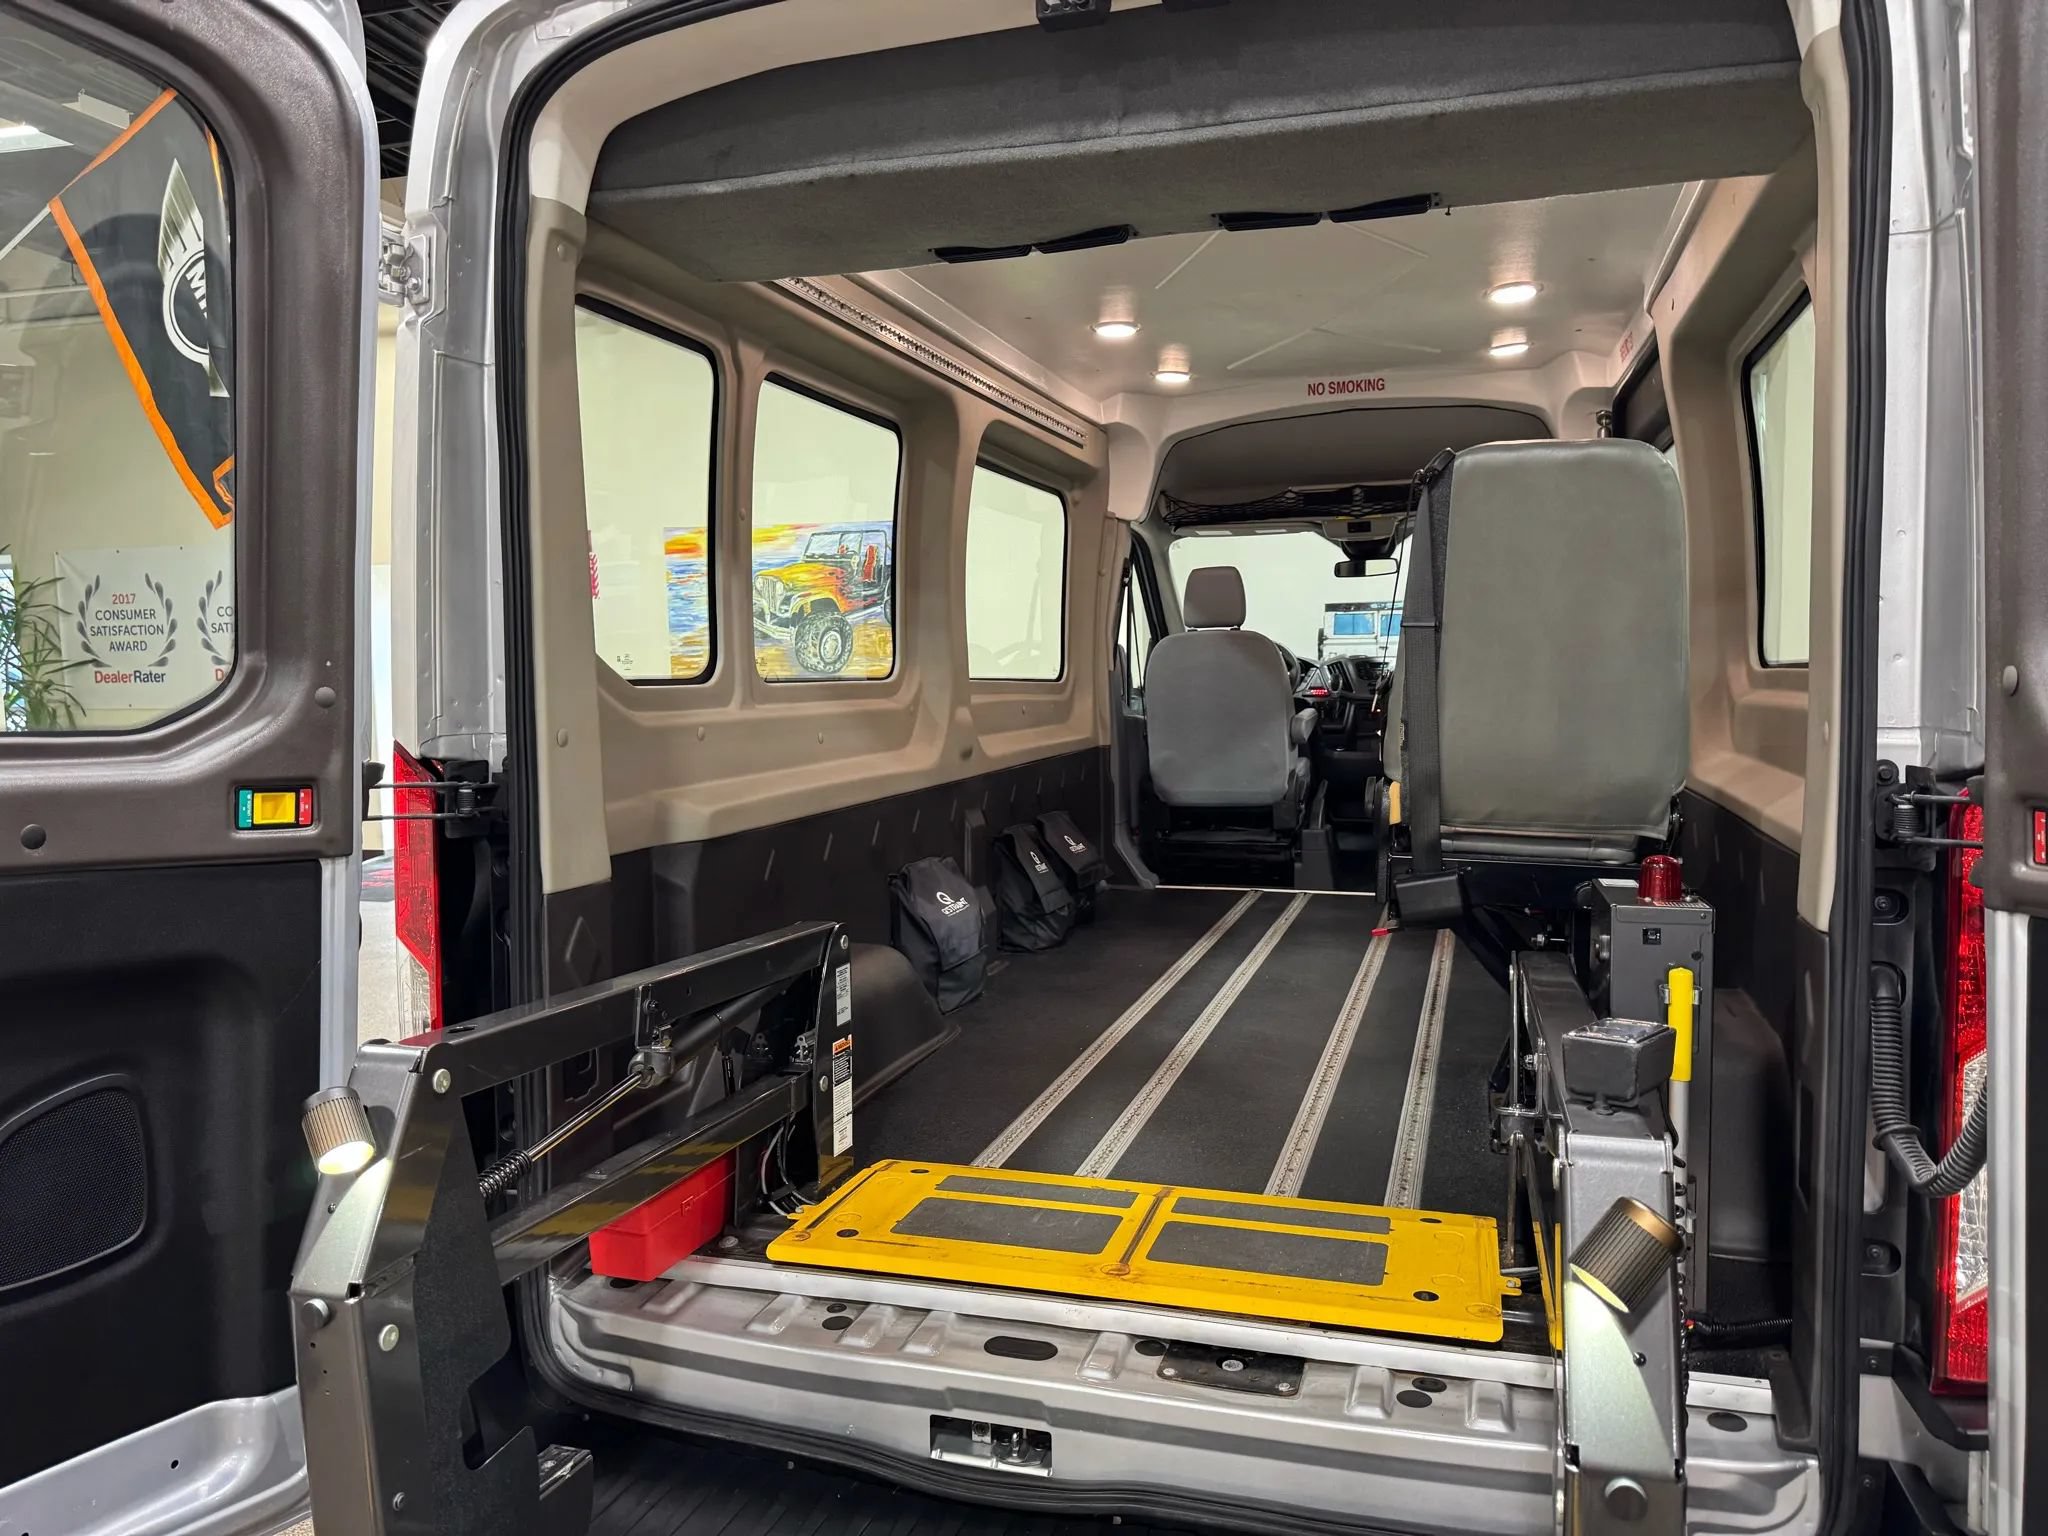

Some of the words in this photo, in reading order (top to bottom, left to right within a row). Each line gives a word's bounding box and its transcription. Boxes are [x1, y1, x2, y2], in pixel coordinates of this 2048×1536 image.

[1307, 382, 1325, 396] NO
[1328, 378, 1385, 395] SMOKING
[112, 593, 136, 605] 2017
[95, 609, 157, 621] CONSUMER
[90, 624, 164, 636] SATISFACTION
[109, 640, 148, 652] AWARD
[94, 670, 166, 683] DealerRater
